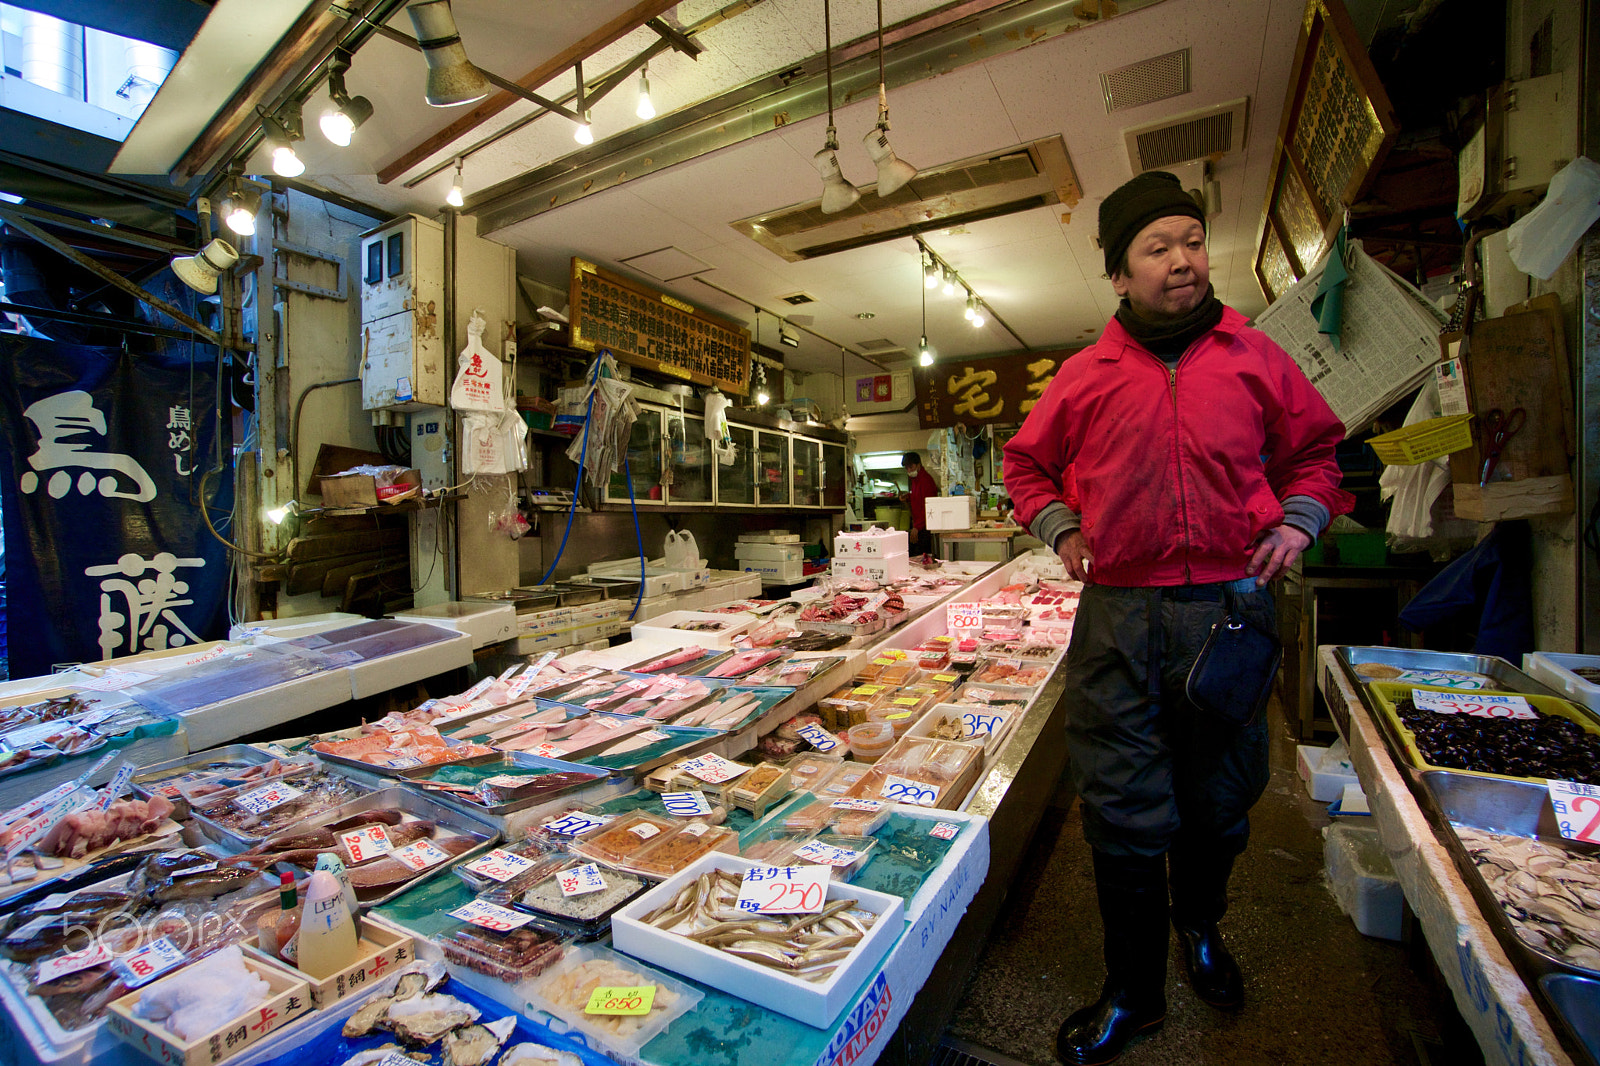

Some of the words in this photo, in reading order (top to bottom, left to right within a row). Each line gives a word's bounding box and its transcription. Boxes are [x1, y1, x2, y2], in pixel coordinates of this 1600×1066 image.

[953, 614, 979, 627] 800
[796, 724, 836, 752] 1650
[661, 792, 702, 815] 1100
[886, 783, 936, 804] 280
[742, 866, 806, 883] 若サギ
[760, 882, 823, 911] 250
[940, 867, 970, 921] NAME
[604, 997, 642, 1010] 650
